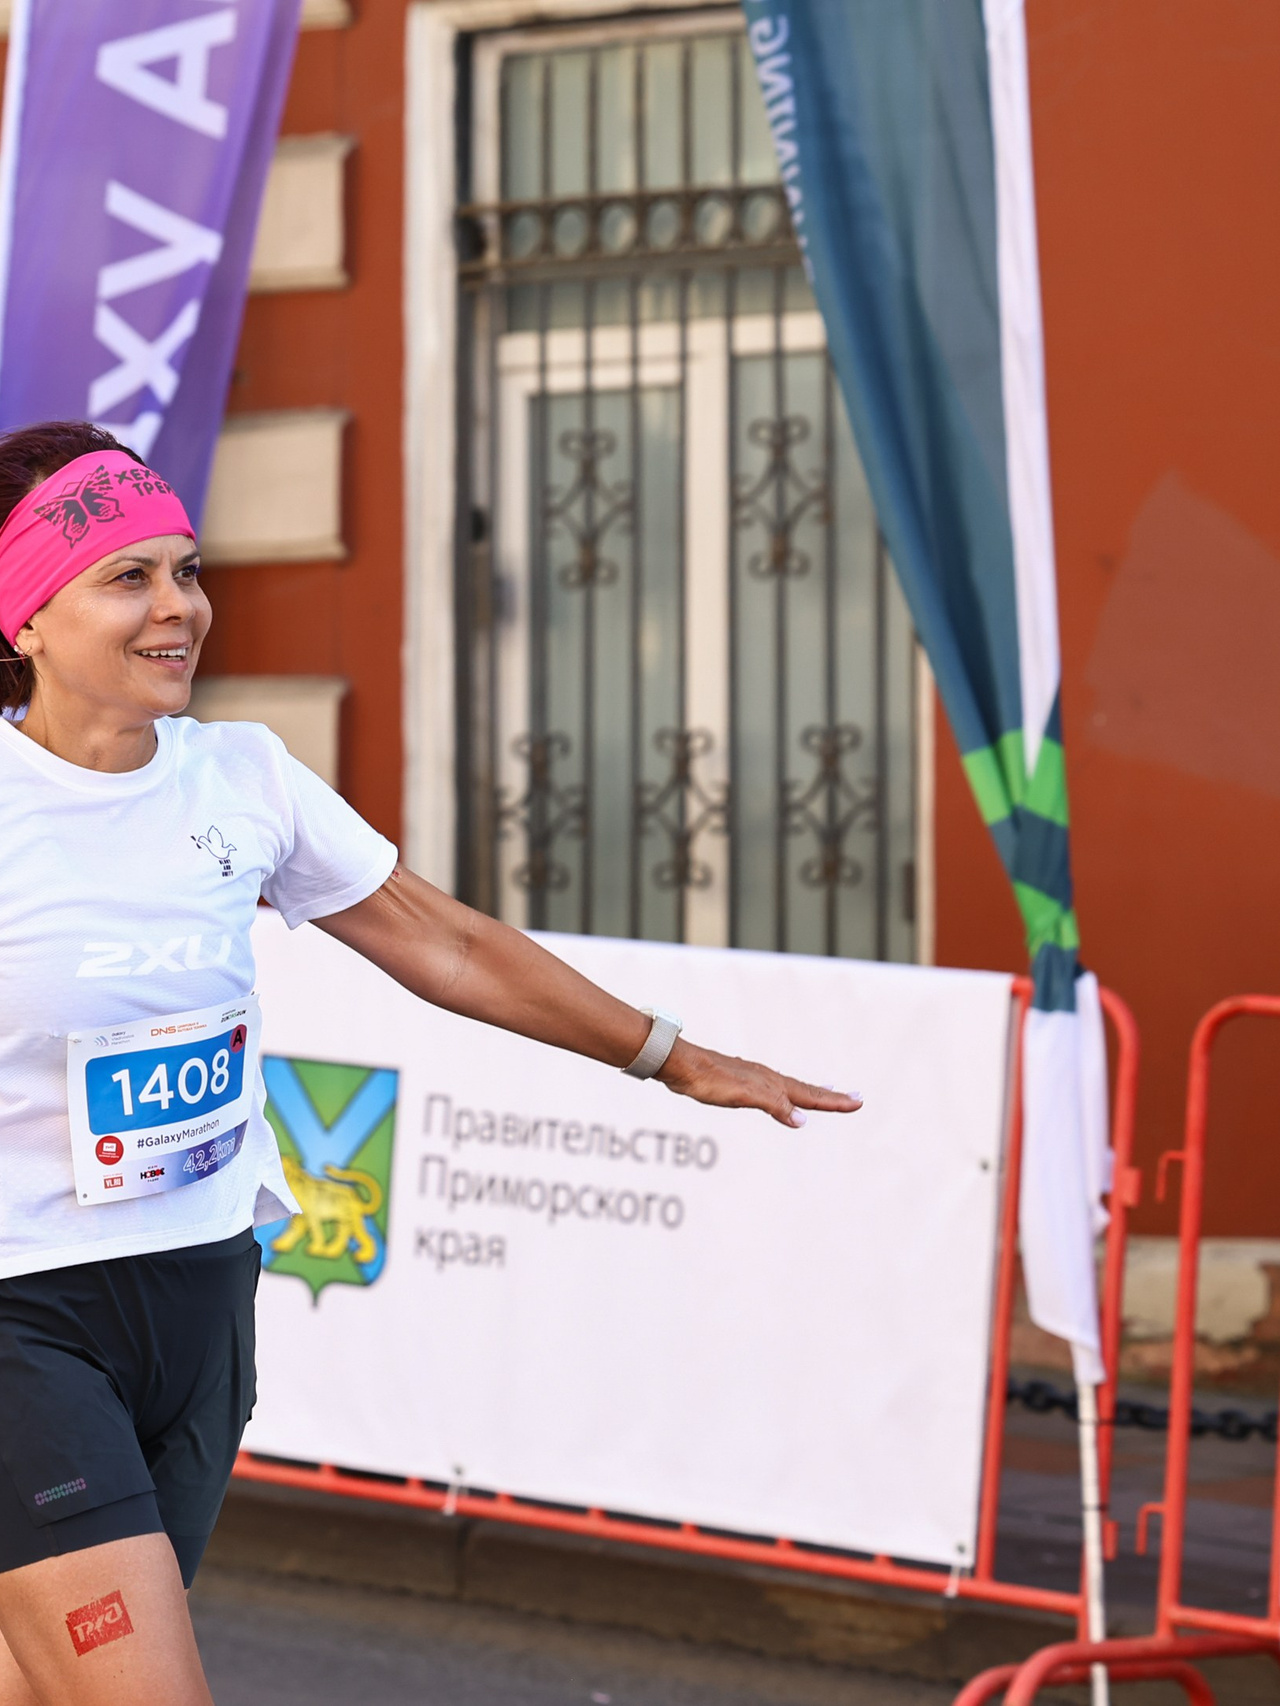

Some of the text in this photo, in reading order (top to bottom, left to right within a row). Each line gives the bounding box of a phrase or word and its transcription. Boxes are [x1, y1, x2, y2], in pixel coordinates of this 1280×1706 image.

[75, 933, 232, 979] 2XU
[150, 1025, 177, 1037] DNS
[111, 1048, 230, 1116] 1408
[137, 1118, 220, 1149] #GalaxyMarathon
[422, 1091, 719, 1172] Правительство
[183, 1137, 236, 1174] 42,2km
[418, 1152, 686, 1231] Приморского
[414, 1227, 509, 1274] края
